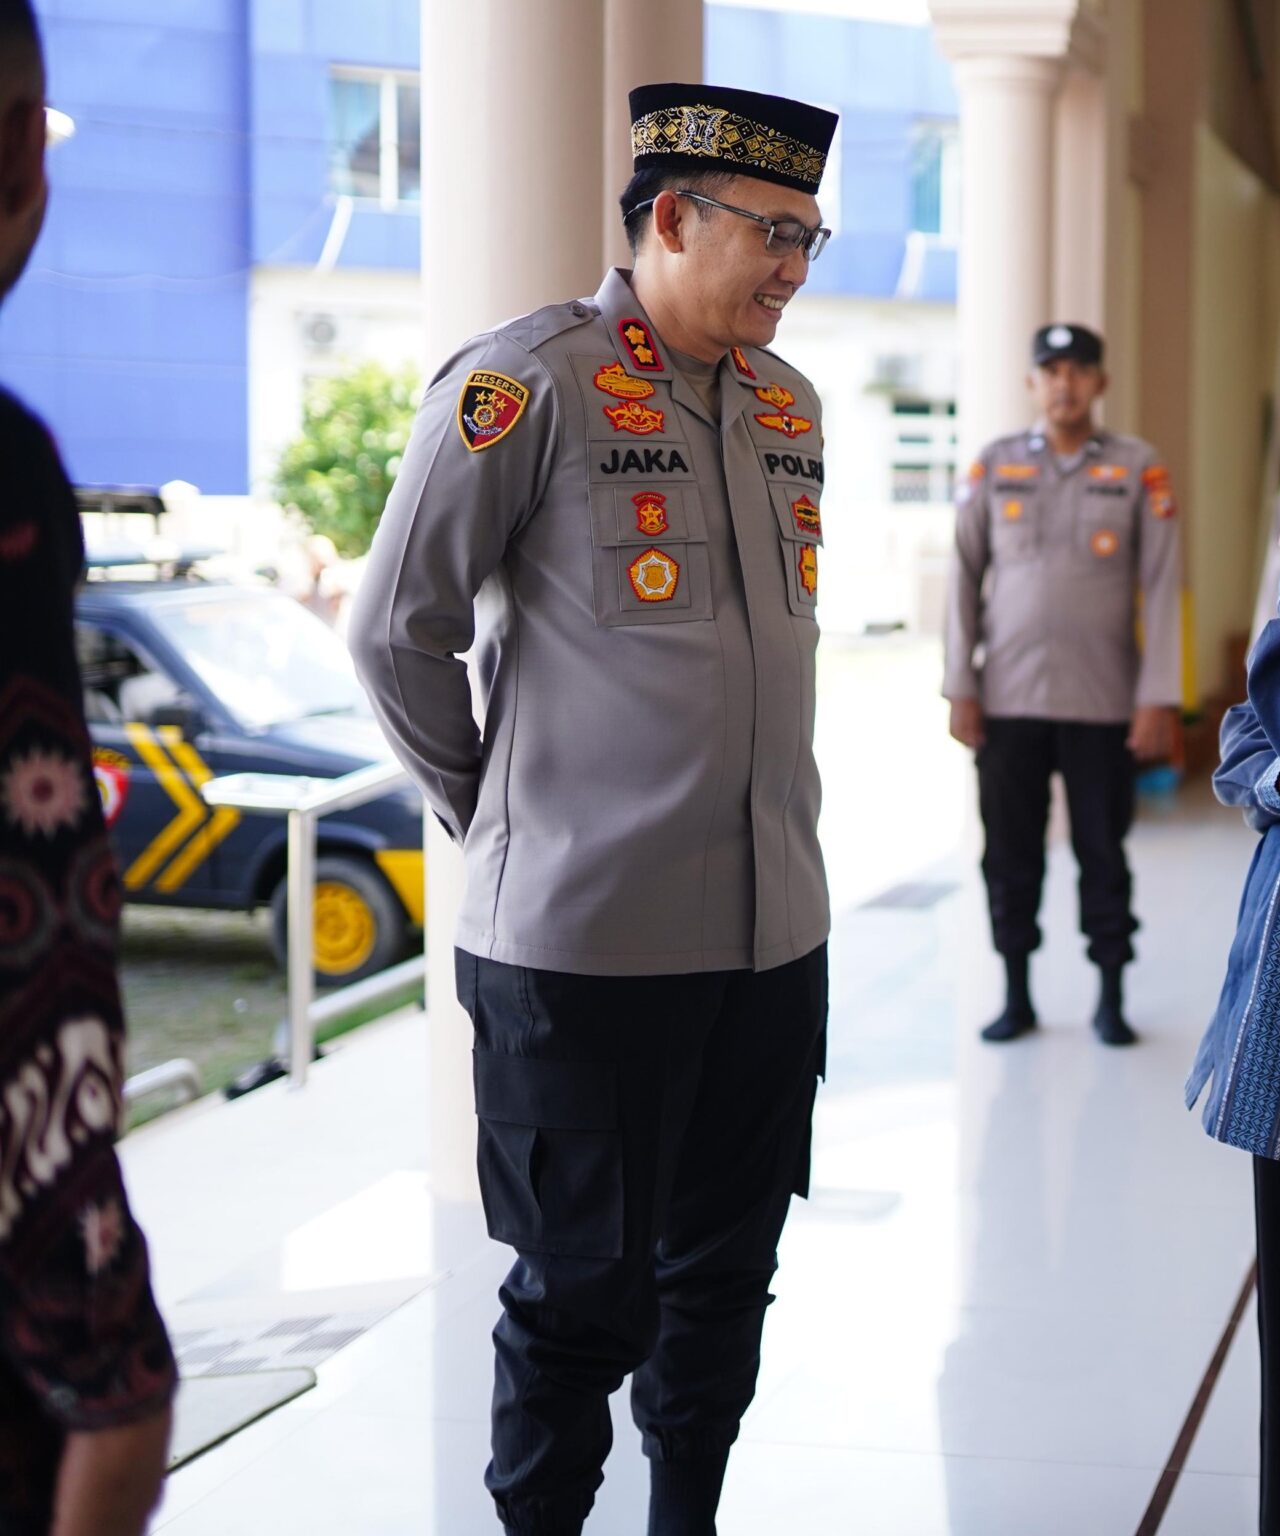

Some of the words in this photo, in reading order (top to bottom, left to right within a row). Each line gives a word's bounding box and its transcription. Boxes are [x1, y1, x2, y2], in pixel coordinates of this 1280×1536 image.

[473, 374, 523, 399] RESERSE
[600, 449, 689, 474] JAKA
[764, 453, 824, 484] POLRI
